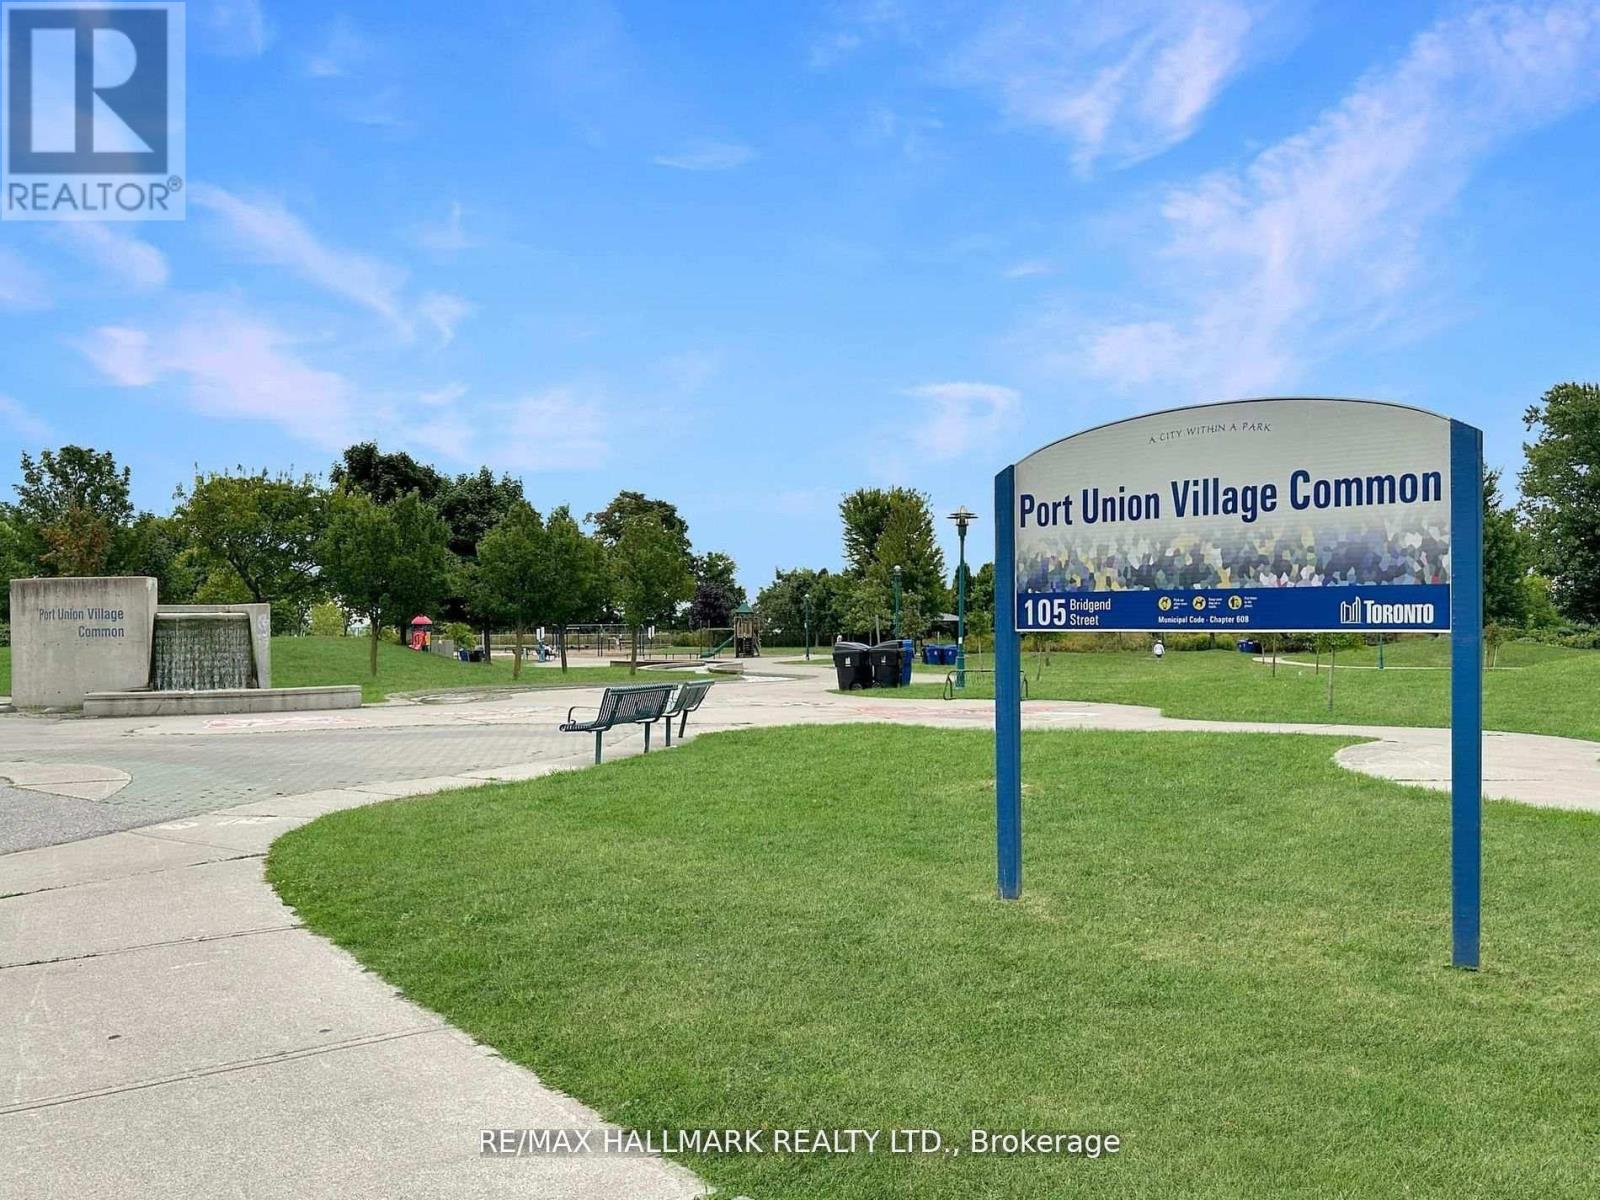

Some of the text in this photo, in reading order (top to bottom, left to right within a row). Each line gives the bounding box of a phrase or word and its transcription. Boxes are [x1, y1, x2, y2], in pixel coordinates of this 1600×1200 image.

[1149, 422, 1271, 444] A CITY WITHIN A PARK
[1020, 469, 1442, 528] Port Union Village Common
[1024, 599, 1067, 626] 105
[1069, 598, 1111, 613] Bridgend
[39, 608, 124, 622] Port Union Village
[1069, 613, 1099, 626] Street
[1158, 616, 1188, 624] Municipal
[1209, 616, 1235, 624] Chapter
[78, 625, 125, 637] Common
